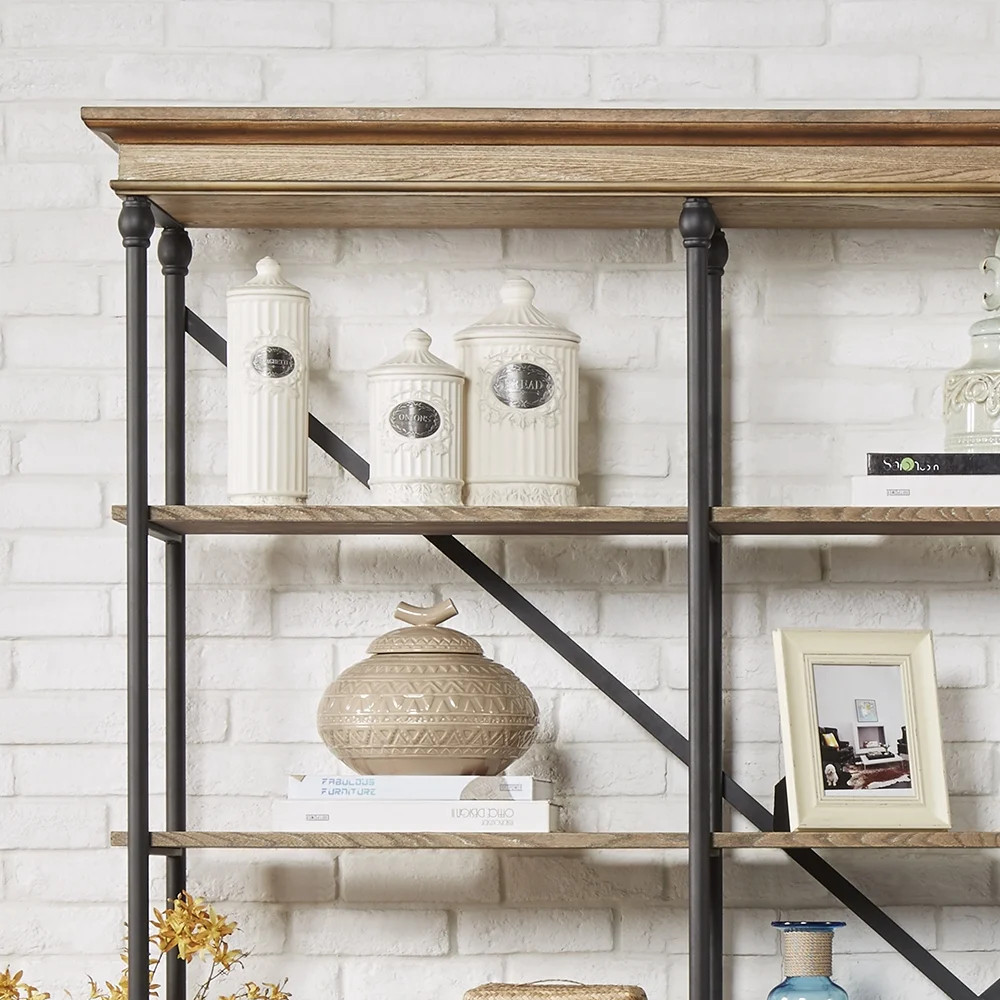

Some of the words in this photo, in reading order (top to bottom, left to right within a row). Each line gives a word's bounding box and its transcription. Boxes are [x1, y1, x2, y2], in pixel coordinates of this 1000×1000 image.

[398, 413, 431, 423] ONONS
[321, 778, 376, 786] FABULOUS
[320, 788, 377, 796] FURNITURE
